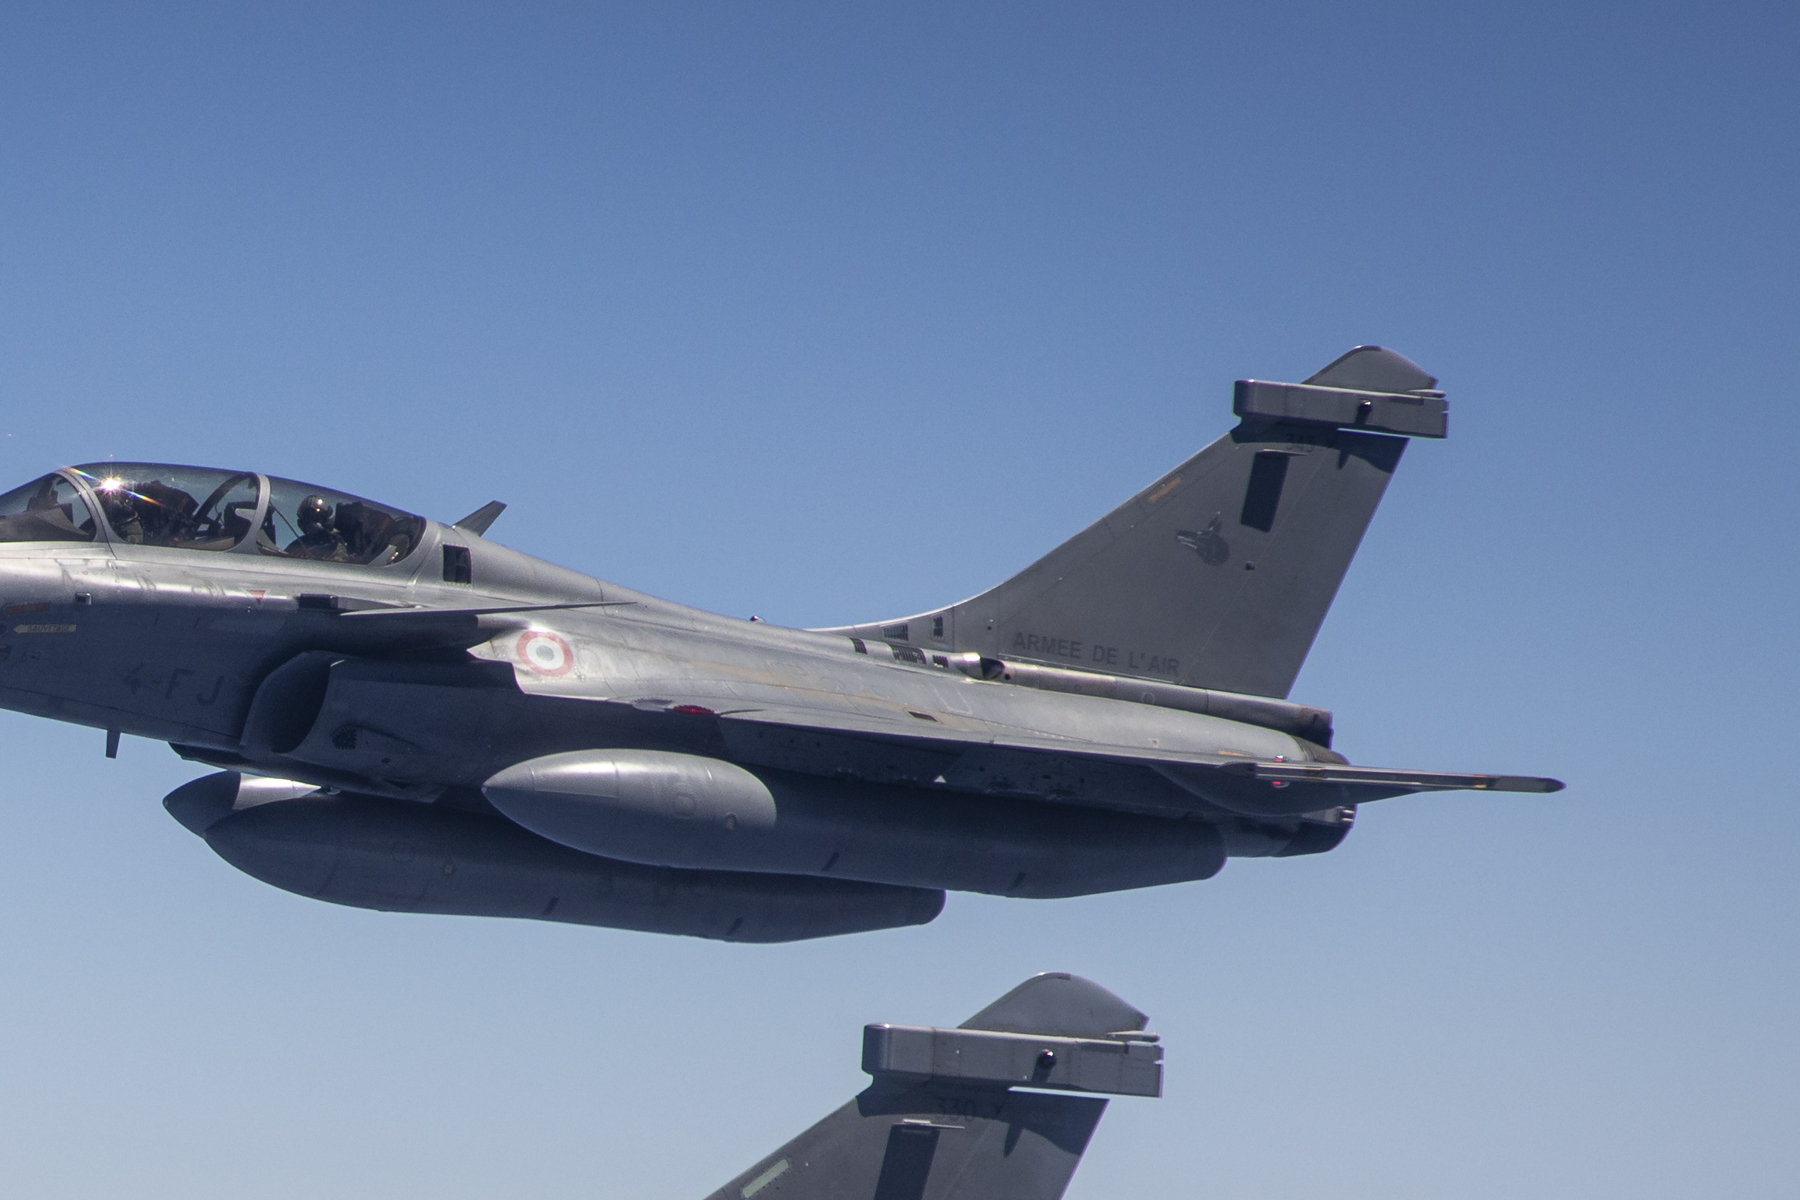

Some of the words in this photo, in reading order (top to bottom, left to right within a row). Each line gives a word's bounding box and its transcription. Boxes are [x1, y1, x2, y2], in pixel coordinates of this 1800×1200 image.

[1012, 632, 1082, 659] ARMEE
[1092, 644, 1118, 665] DE
[1128, 651, 1180, 676] L'AIR
